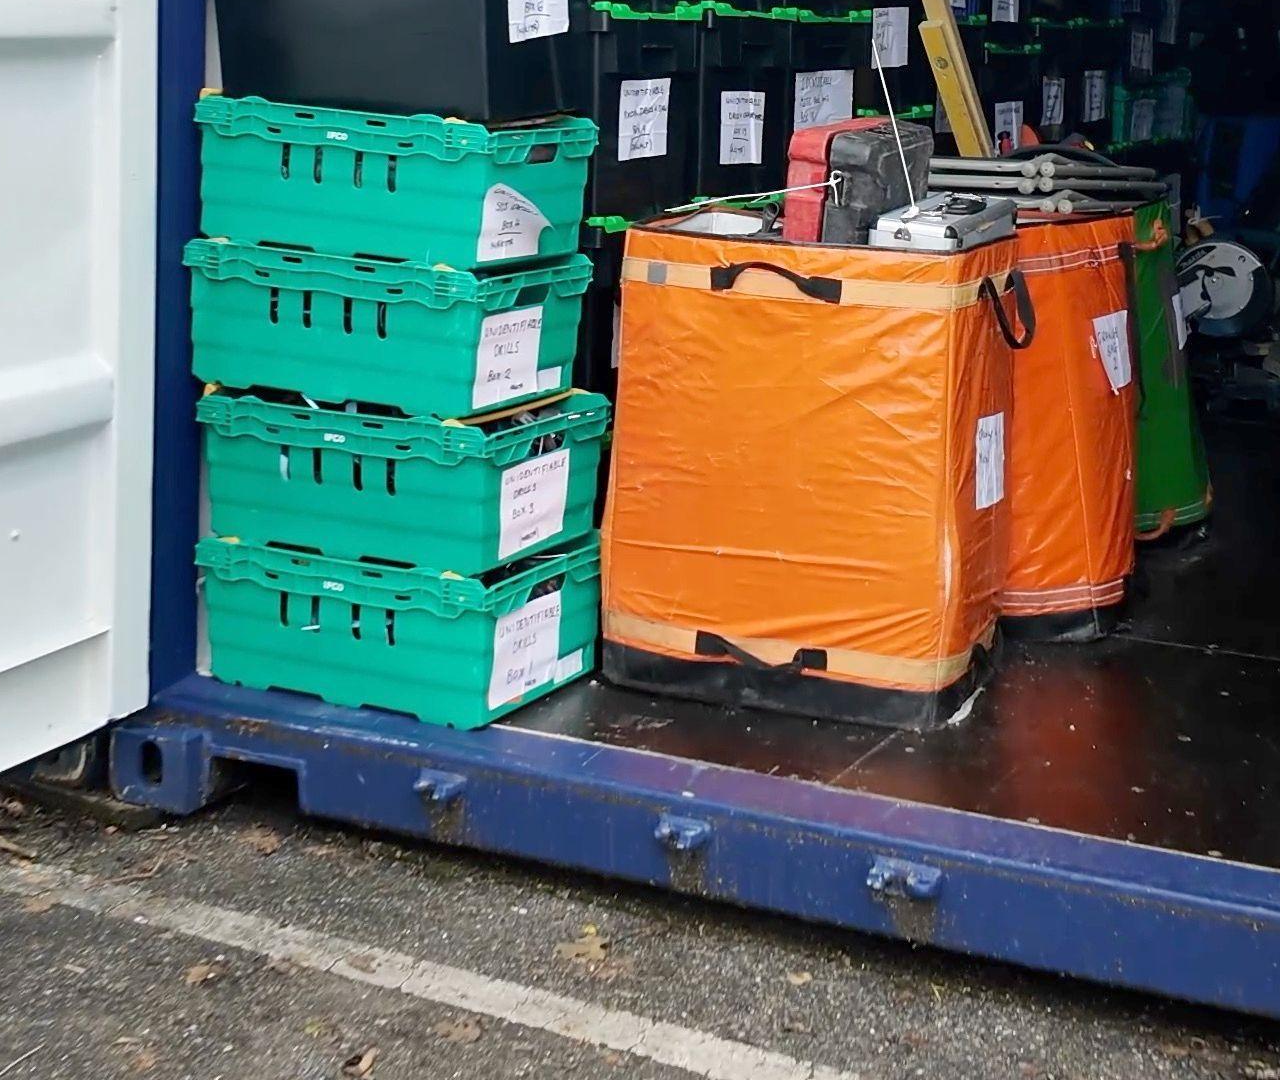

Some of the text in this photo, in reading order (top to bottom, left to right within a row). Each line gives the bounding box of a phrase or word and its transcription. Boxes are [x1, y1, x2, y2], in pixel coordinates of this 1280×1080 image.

[485, 318, 542, 338] UNIDENTIFIABLE
[494, 341, 520, 357] DRILLS
[504, 368, 512, 380] 2
[505, 456, 567, 486] UNIDENTIFIABLE
[499, 604, 560, 638] UNIDENTIFIABLE
[513, 633, 537, 654] DRILLS
